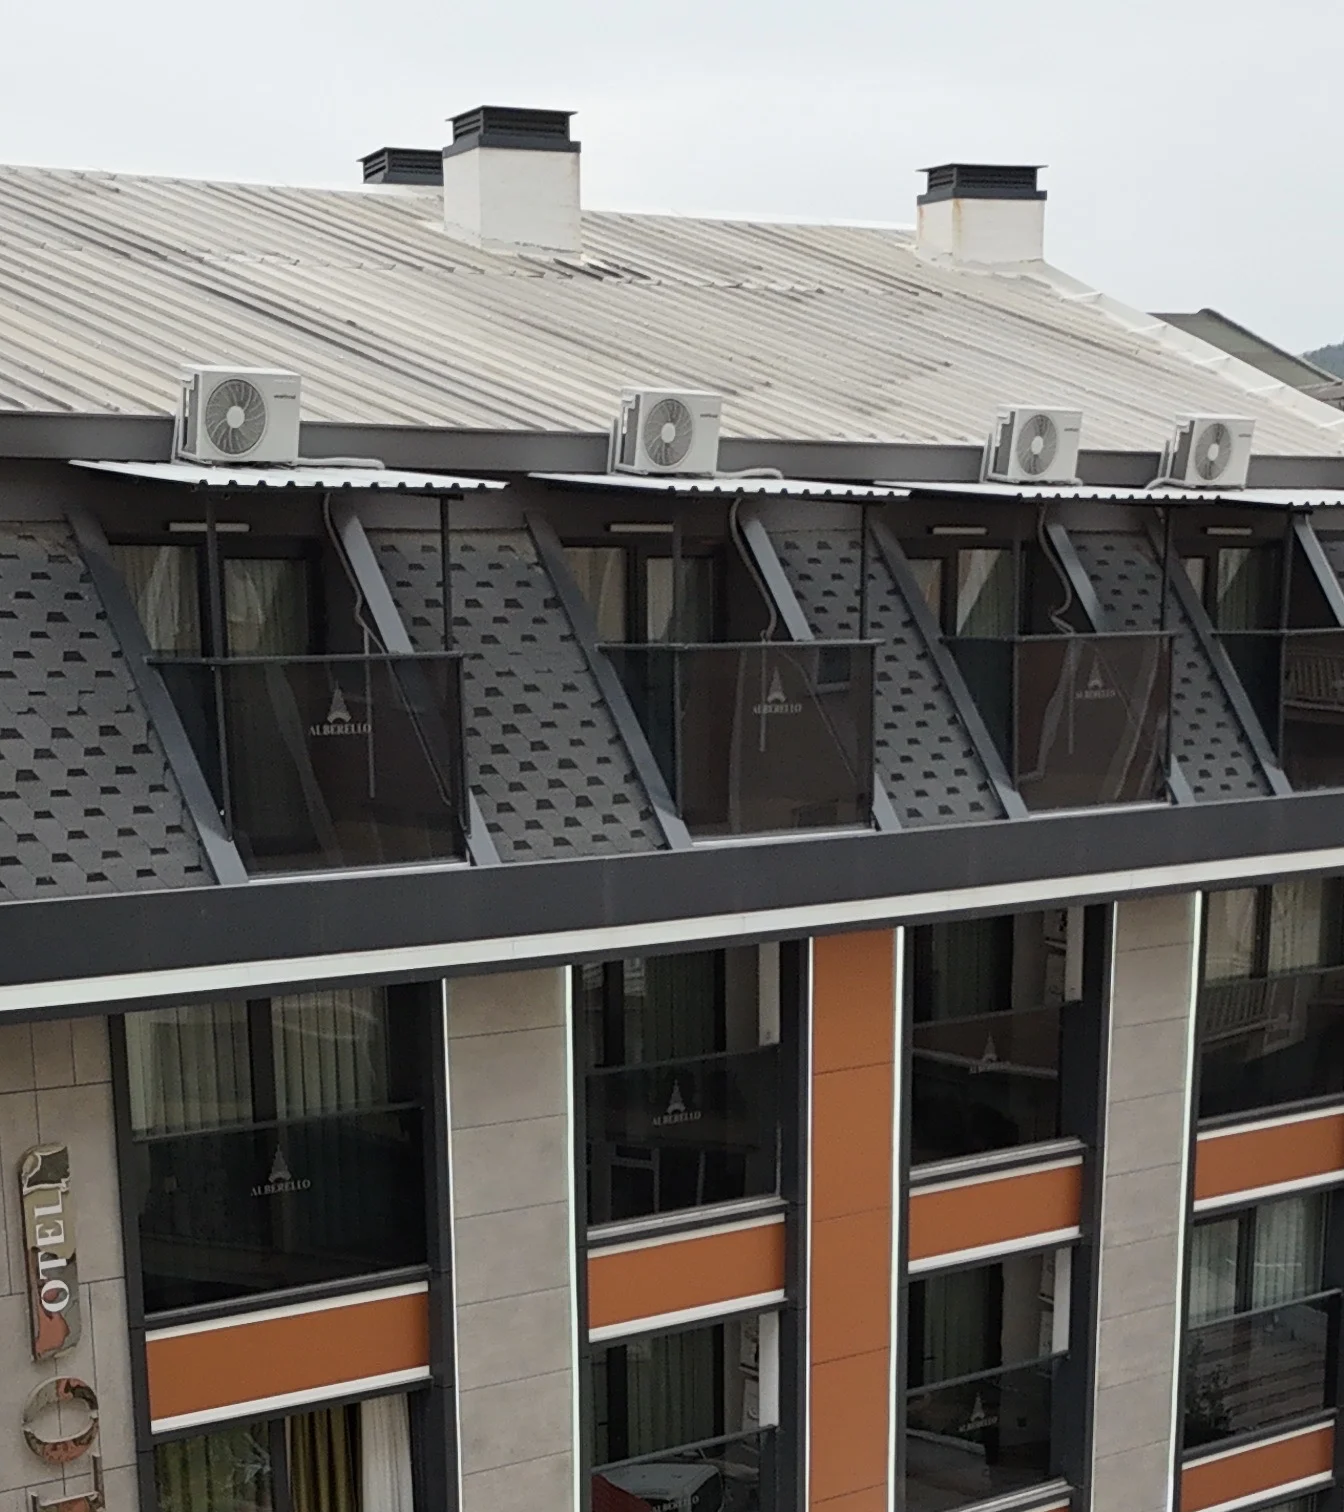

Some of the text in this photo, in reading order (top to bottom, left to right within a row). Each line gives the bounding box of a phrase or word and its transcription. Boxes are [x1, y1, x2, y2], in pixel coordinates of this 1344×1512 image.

[308, 723, 372, 737] ALBERELLO
[250, 1178, 312, 1198] ALBERELLO
[34, 1189, 71, 1313] OTEL
